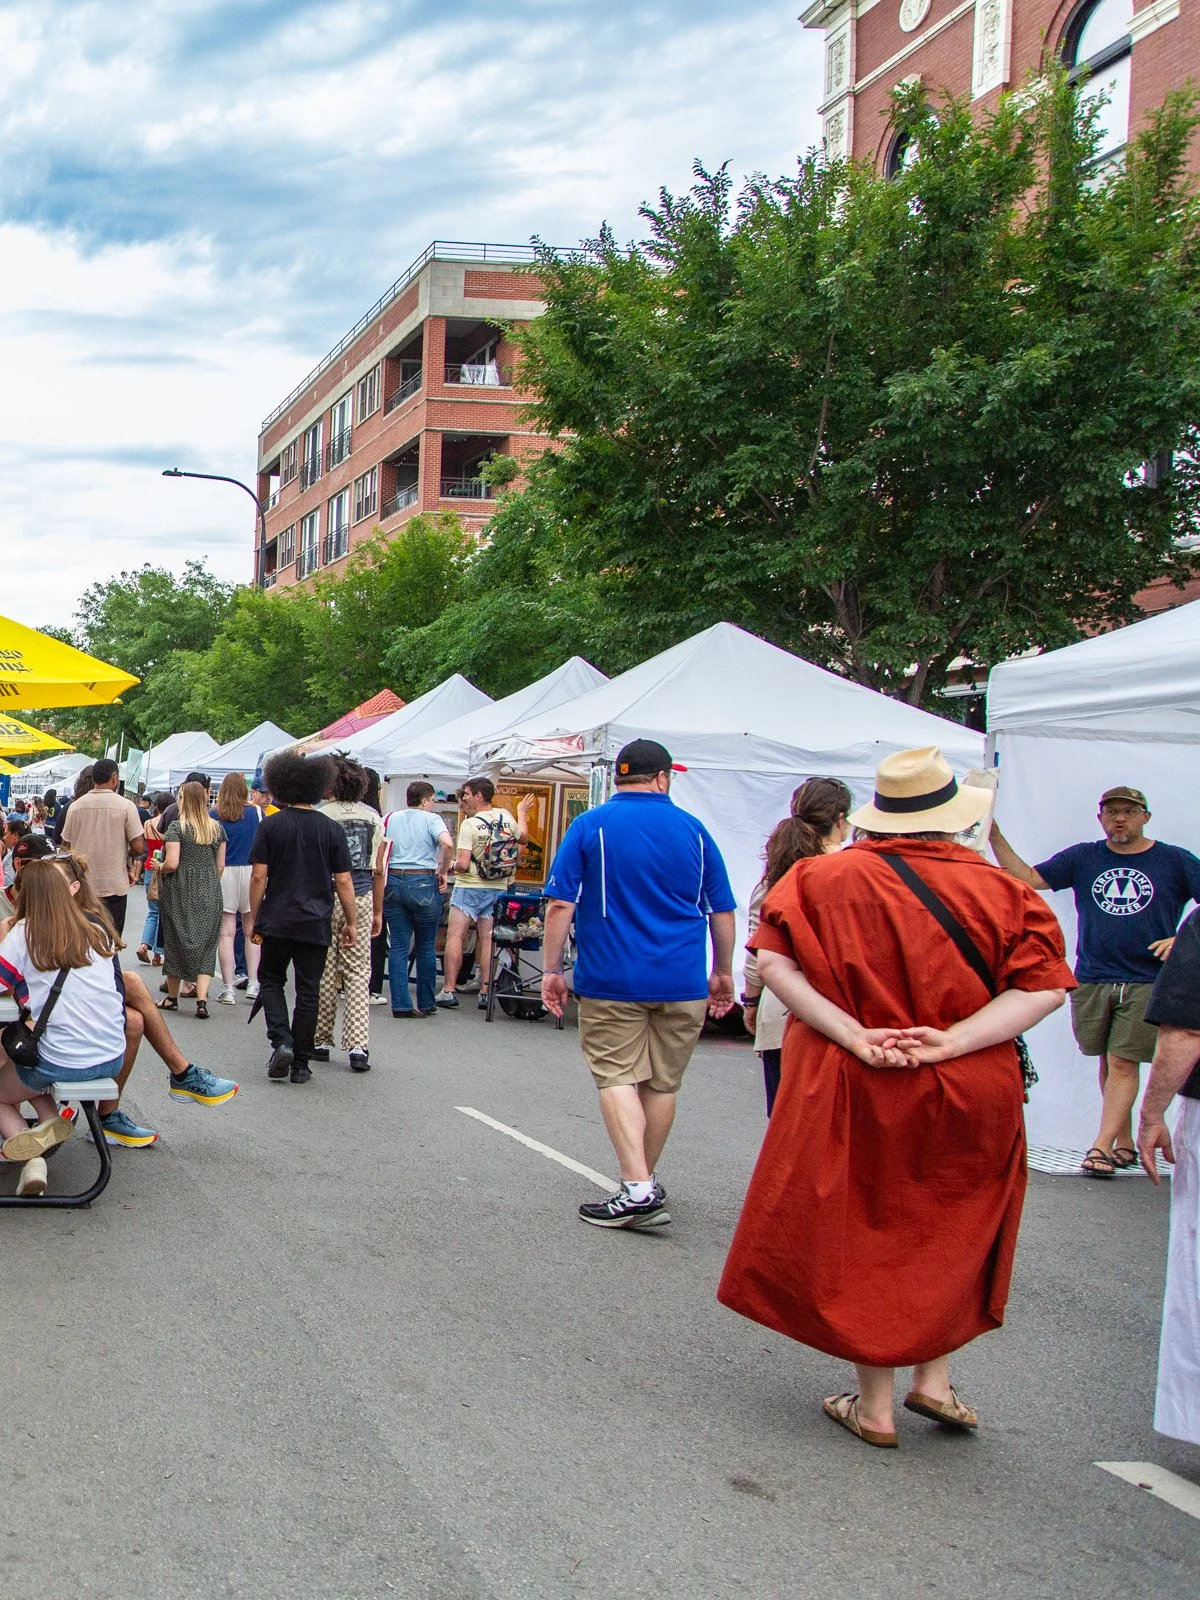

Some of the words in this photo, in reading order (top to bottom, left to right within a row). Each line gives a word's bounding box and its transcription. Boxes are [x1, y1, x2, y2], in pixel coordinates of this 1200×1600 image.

[1094, 869, 1125, 894] CIRCLE
[1128, 870, 1151, 896] PINES
[1101, 901, 1141, 913] CENTER
[187, 1084, 208, 1096] HOKA
